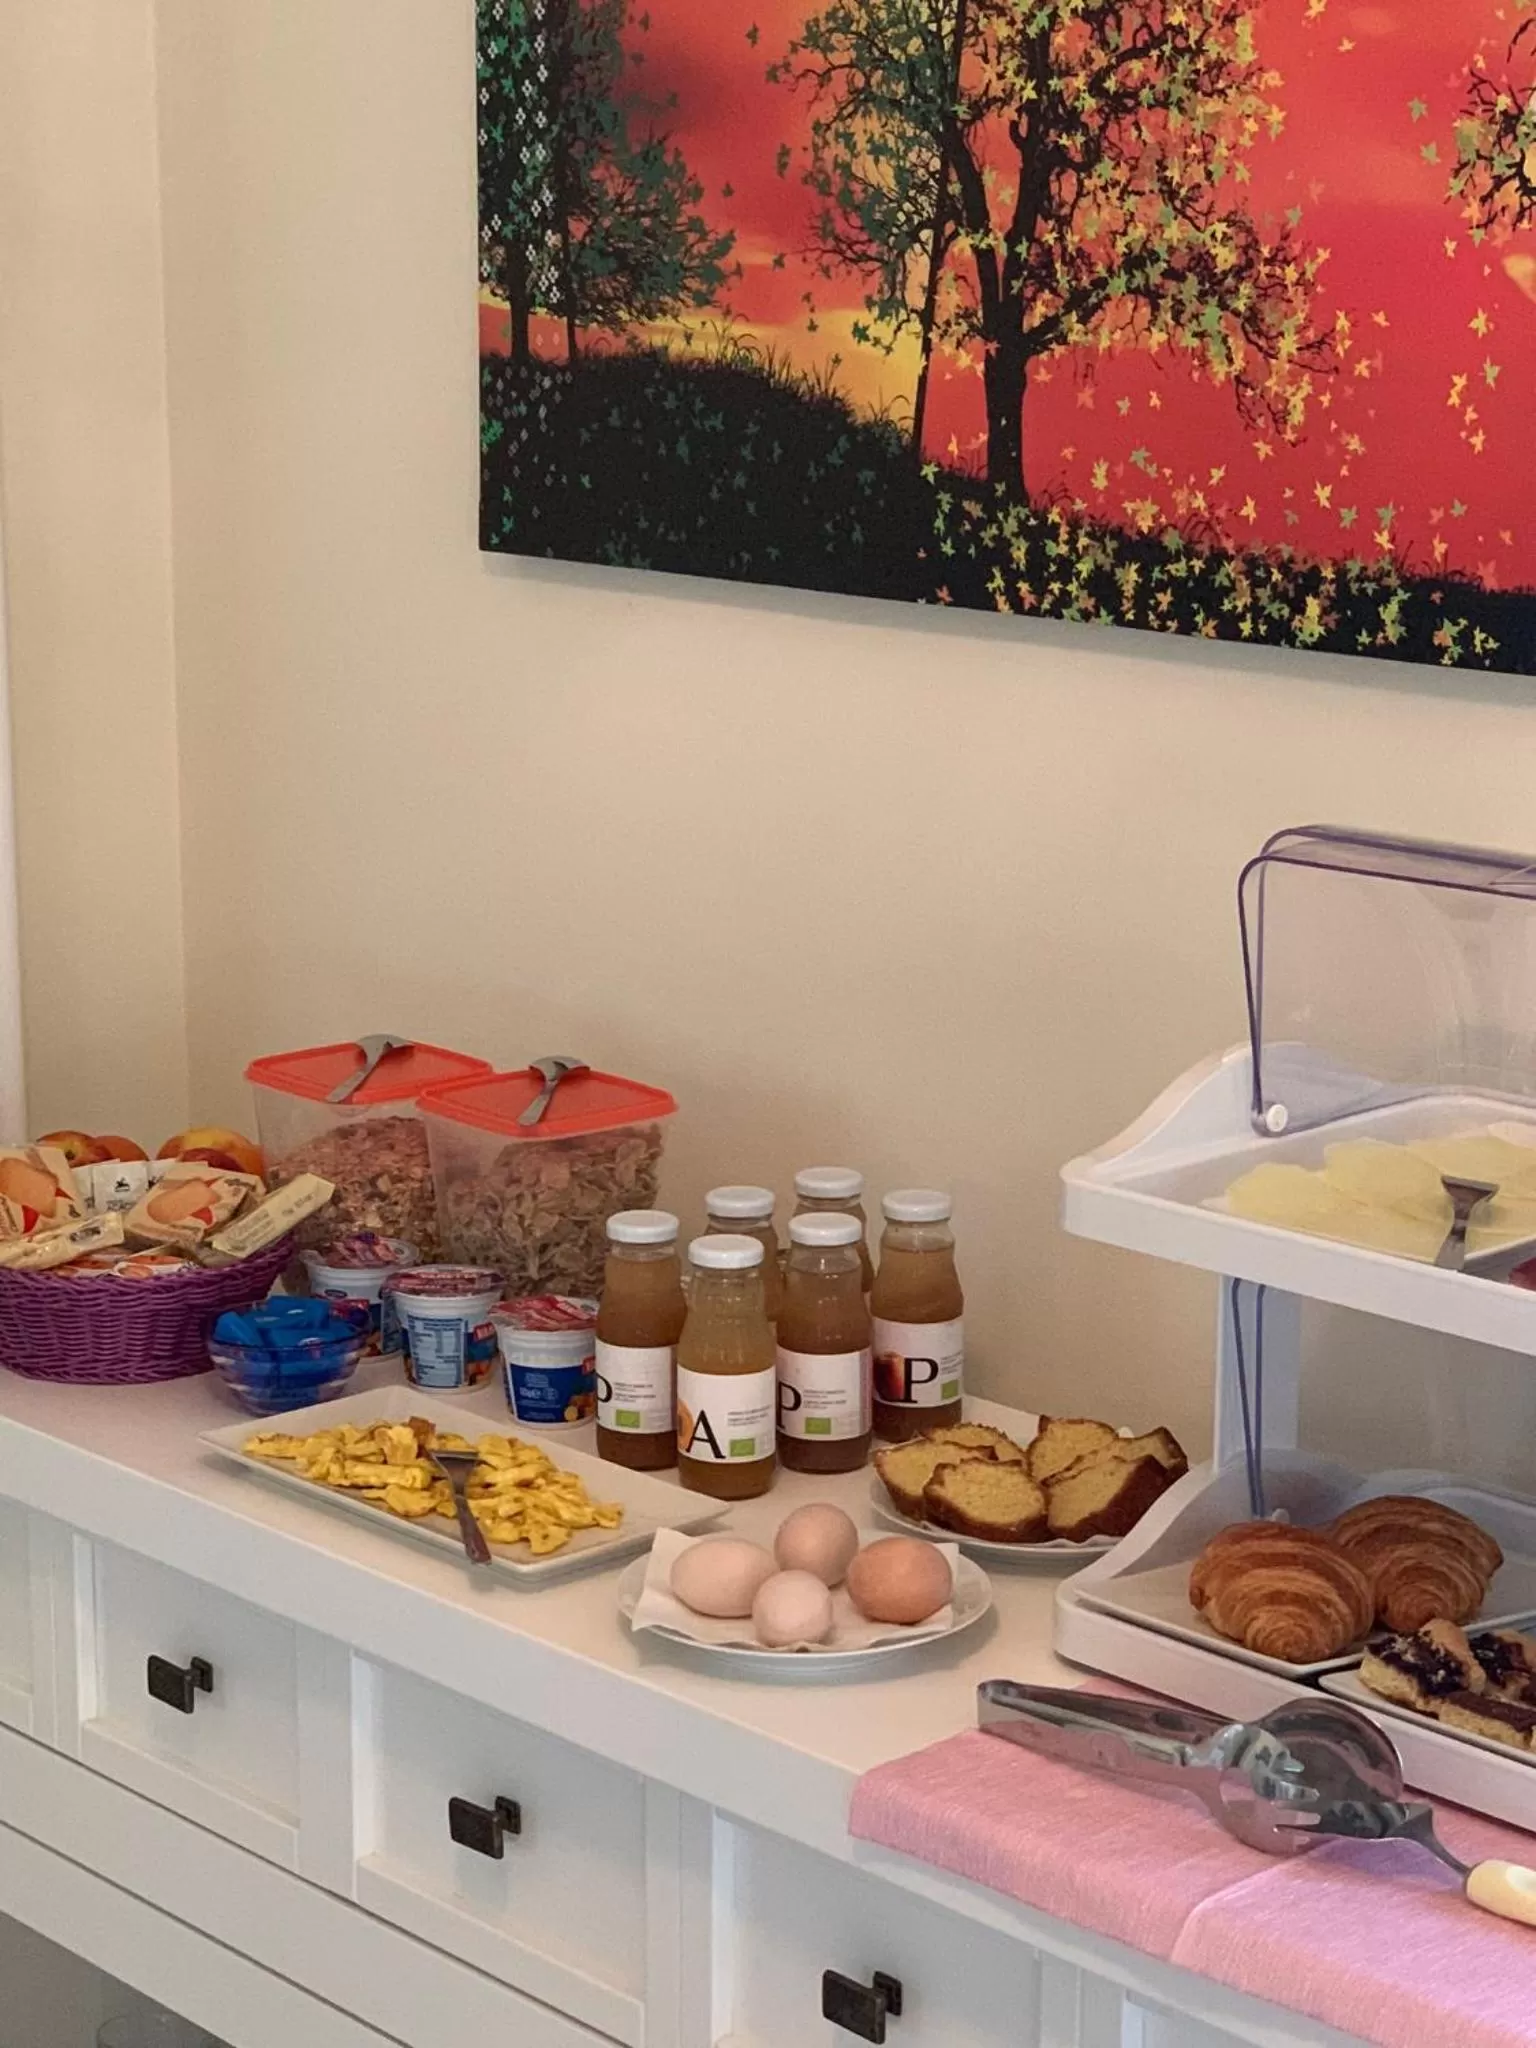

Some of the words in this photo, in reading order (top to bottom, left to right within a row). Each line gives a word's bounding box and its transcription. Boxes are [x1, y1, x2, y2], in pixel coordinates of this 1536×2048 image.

[904, 1357, 939, 1403] P
[777, 1381, 802, 1429] P
[686, 1409, 726, 1459] A
